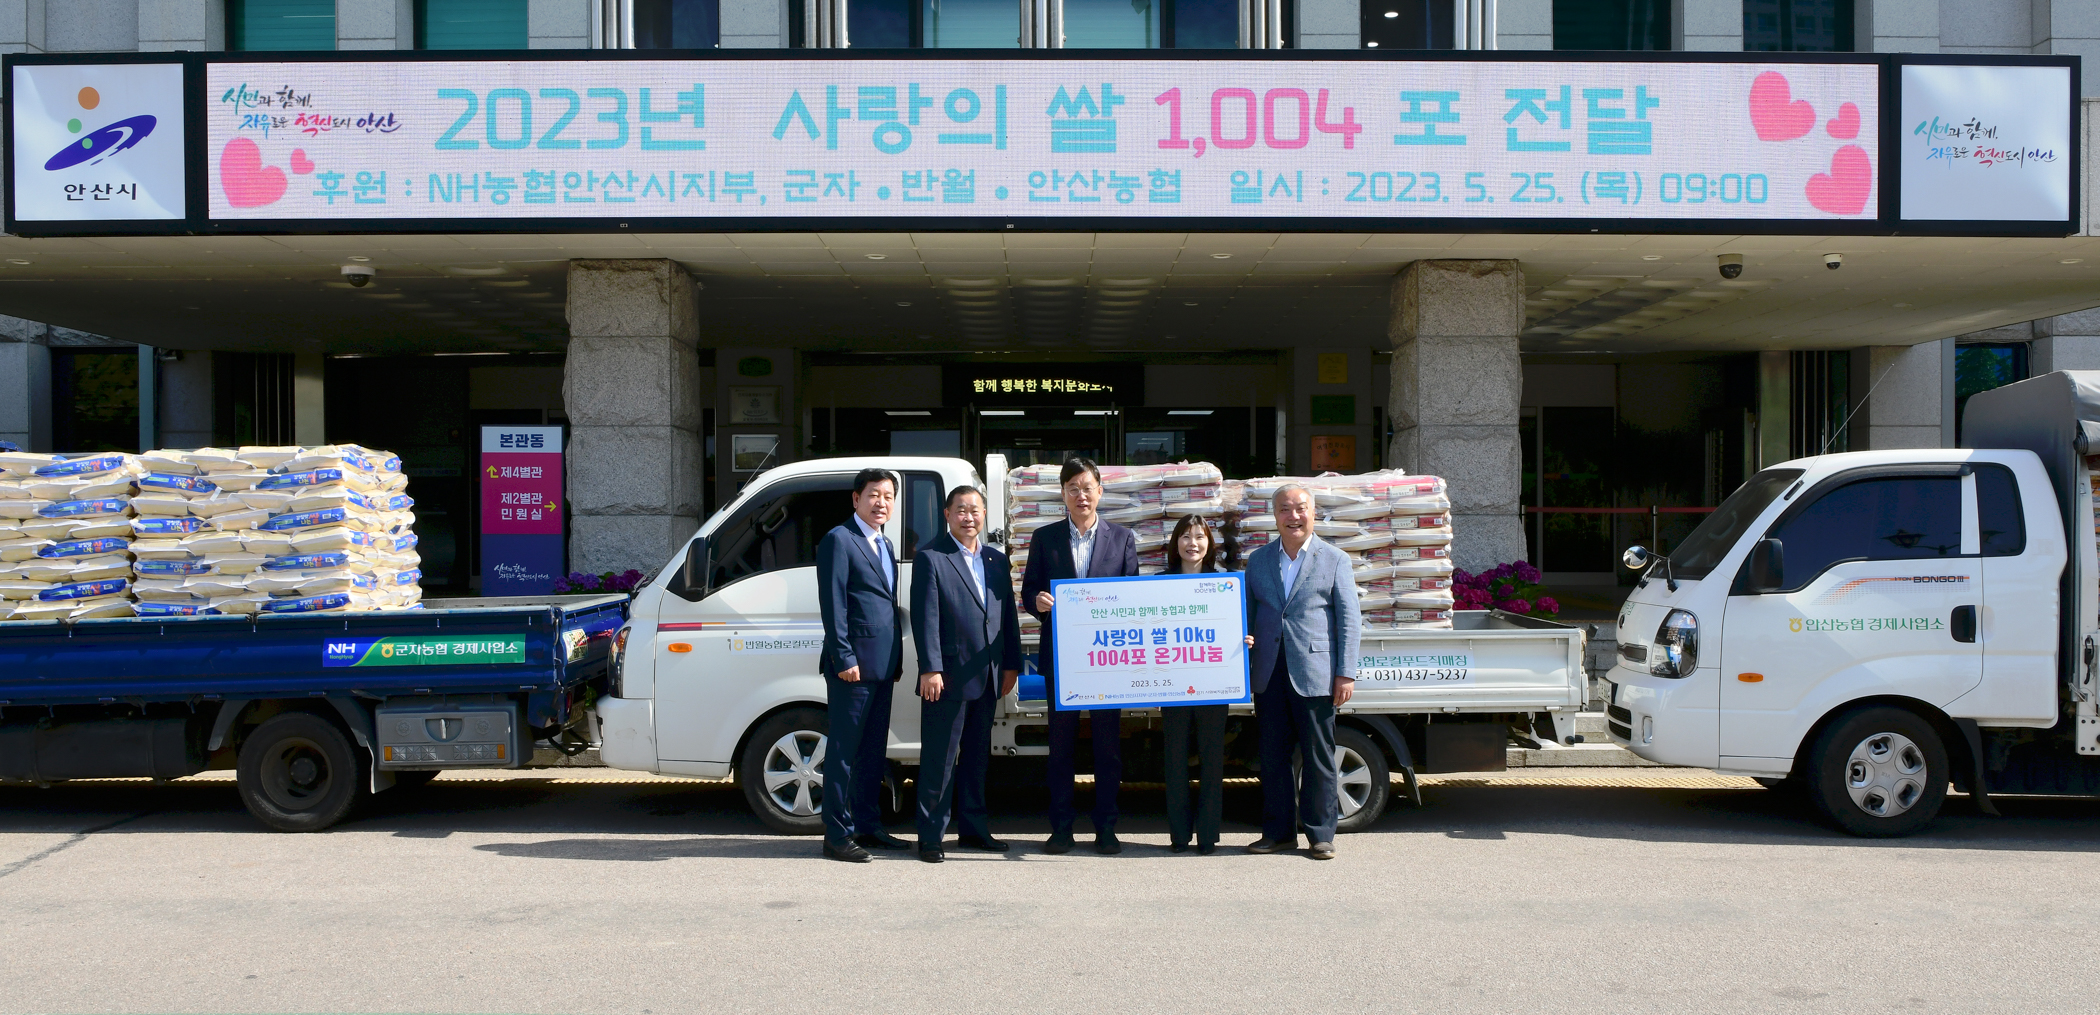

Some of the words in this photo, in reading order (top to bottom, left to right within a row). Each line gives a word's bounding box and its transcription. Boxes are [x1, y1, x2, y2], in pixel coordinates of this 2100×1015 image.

[222, 82, 275, 115] 시민과
[238, 114, 290, 139] 자유로운
[293, 112, 351, 138] 혁신도시
[356, 112, 402, 134] 안산
[434, 83, 706, 151] 2023년
[772, 82, 1007, 155] 사랑의
[1045, 83, 1125, 153] 쌀
[1154, 87, 1363, 159] 1,004
[1393, 90, 1467, 146] 포
[1503, 84, 1660, 155] 전달
[1913, 115, 1964, 146] 시민과
[1926, 146, 1970, 170] 자유로운
[1973, 145, 2025, 169] 혁신도시
[2028, 148, 2058, 163] 안산
[63, 183, 137, 201] 안산시
[312, 170, 387, 205] 후원
[428, 169, 767, 206] NH농협안산시지부,
[783, 170, 861, 202] 군자
[901, 168, 975, 204] 반월
[1027, 168, 1182, 204] 안산농협
[1230, 169, 1303, 204] 일시
[1345, 171, 1450, 203] 2023.
[1464, 172, 1494, 203] 5.
[1510, 172, 1564, 203] 25.
[1580, 170, 1643, 205] (목)
[1659, 172, 1768, 204] 09:00
[973, 379, 997, 393] 함께
[1000, 379, 1037, 393] 행복한
[500, 433, 544, 448] 본관동
[500, 466, 543, 479] 제4별관
[501, 492, 543, 505] 제2별관
[1090, 608, 1108, 619] 안산
[1110, 607, 1136, 618] 시민과
[1138, 606, 1158, 617] 함께!
[1161, 605, 1187, 616] 농협과
[1188, 604, 1209, 615] 함께!
[1805, 618, 1864, 632] 안산농협
[1867, 617, 1945, 632] 경제사업소
[1092, 628, 1144, 647] 사랑의
[1151, 627, 1168, 645] 쌀
[1173, 626, 1216, 643] 10kg
[328, 643, 356, 654] NH
[395, 643, 448, 656] 군자농협
[452, 641, 518, 655] 경제사업소
[1087, 648, 1147, 667] 1004포
[1154, 645, 1223, 665] 온기나눔
[1131, 680, 1152, 688] 2023.
[1162, 679, 1174, 687] 25.
